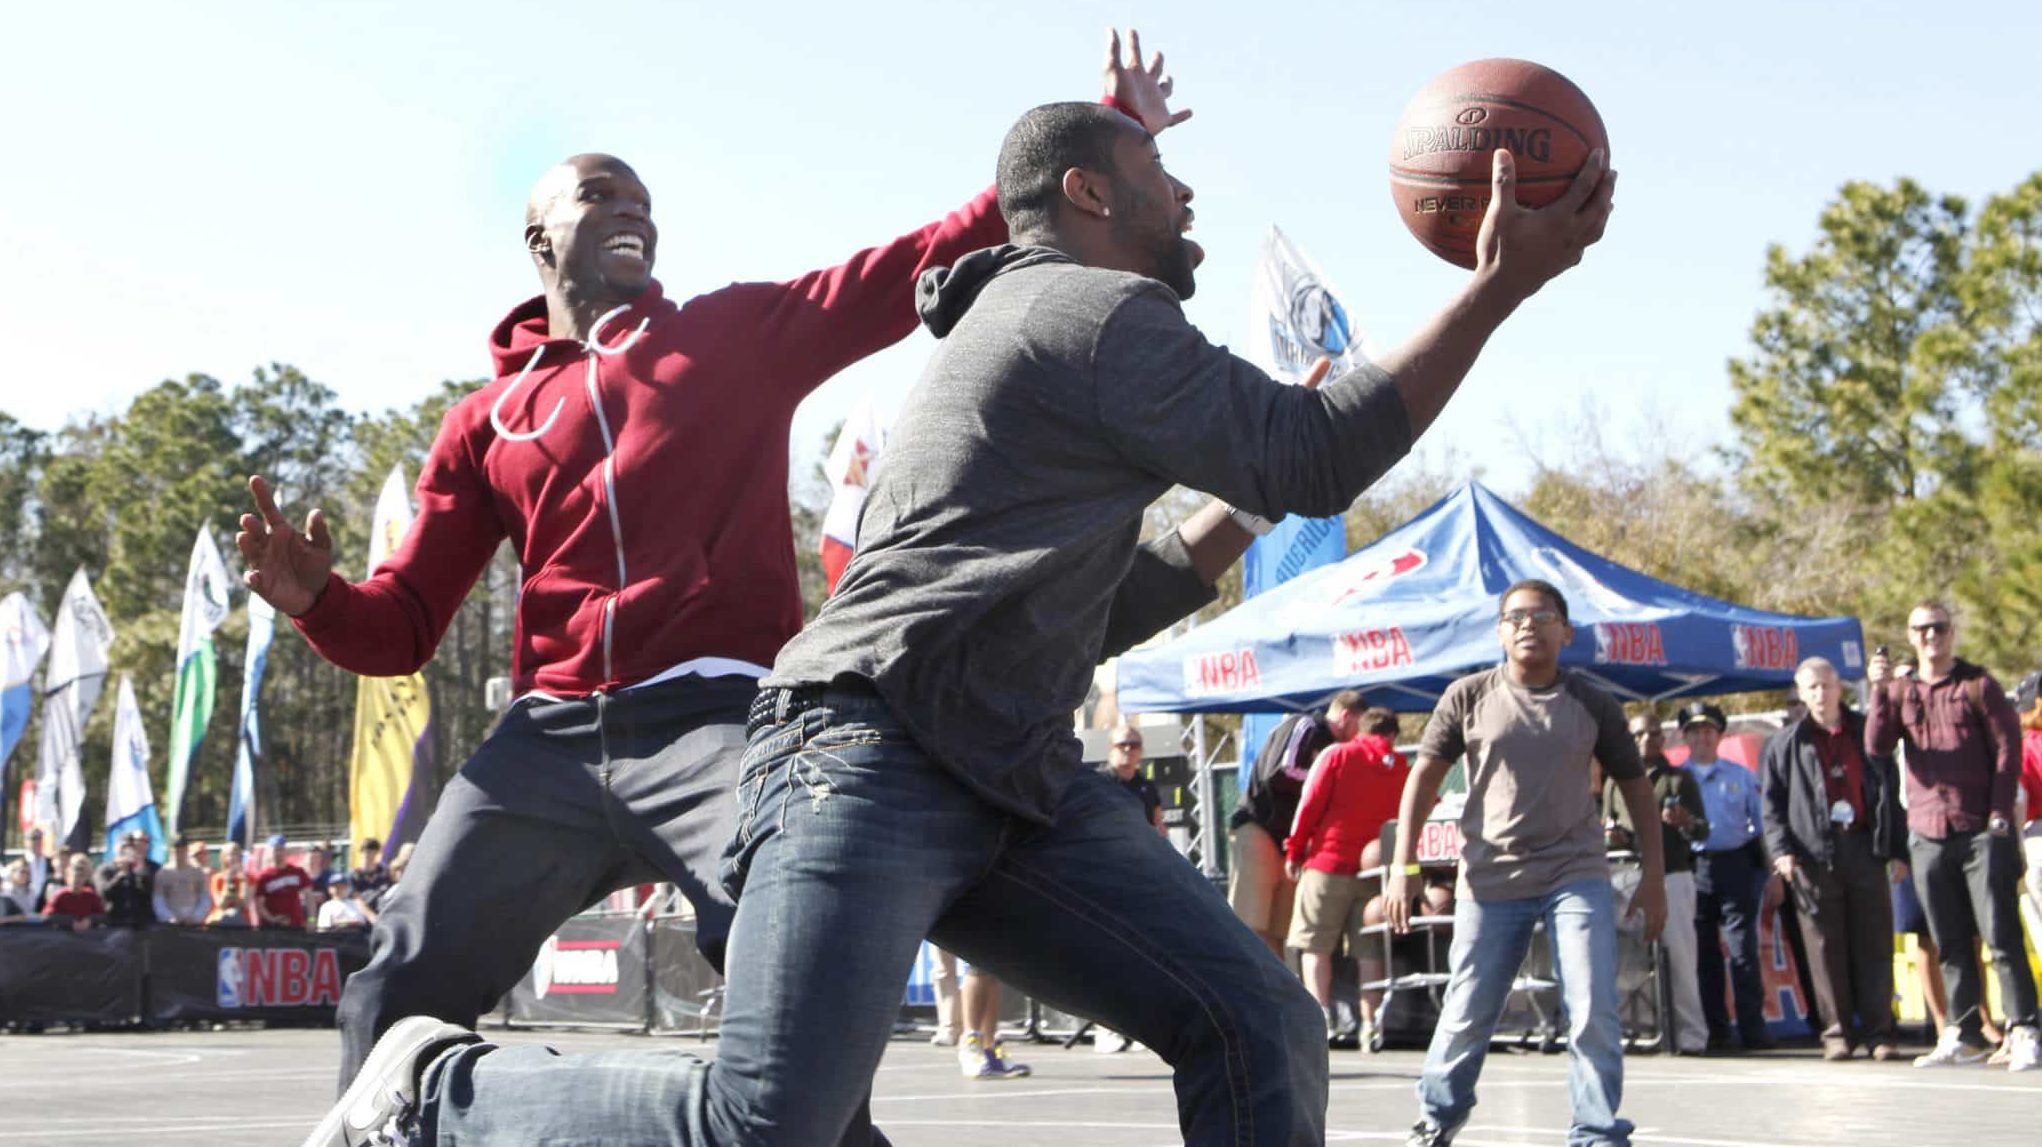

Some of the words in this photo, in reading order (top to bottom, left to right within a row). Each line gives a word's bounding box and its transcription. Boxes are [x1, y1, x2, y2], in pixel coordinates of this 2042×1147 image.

[1415, 196, 1476, 214] NEVER
[1344, 627, 1414, 672] NBA
[1608, 622, 1668, 666] NBA
[1745, 627, 1798, 668] NBA
[1199, 650, 1261, 691] NBA
[246, 948, 341, 1006] NBA
